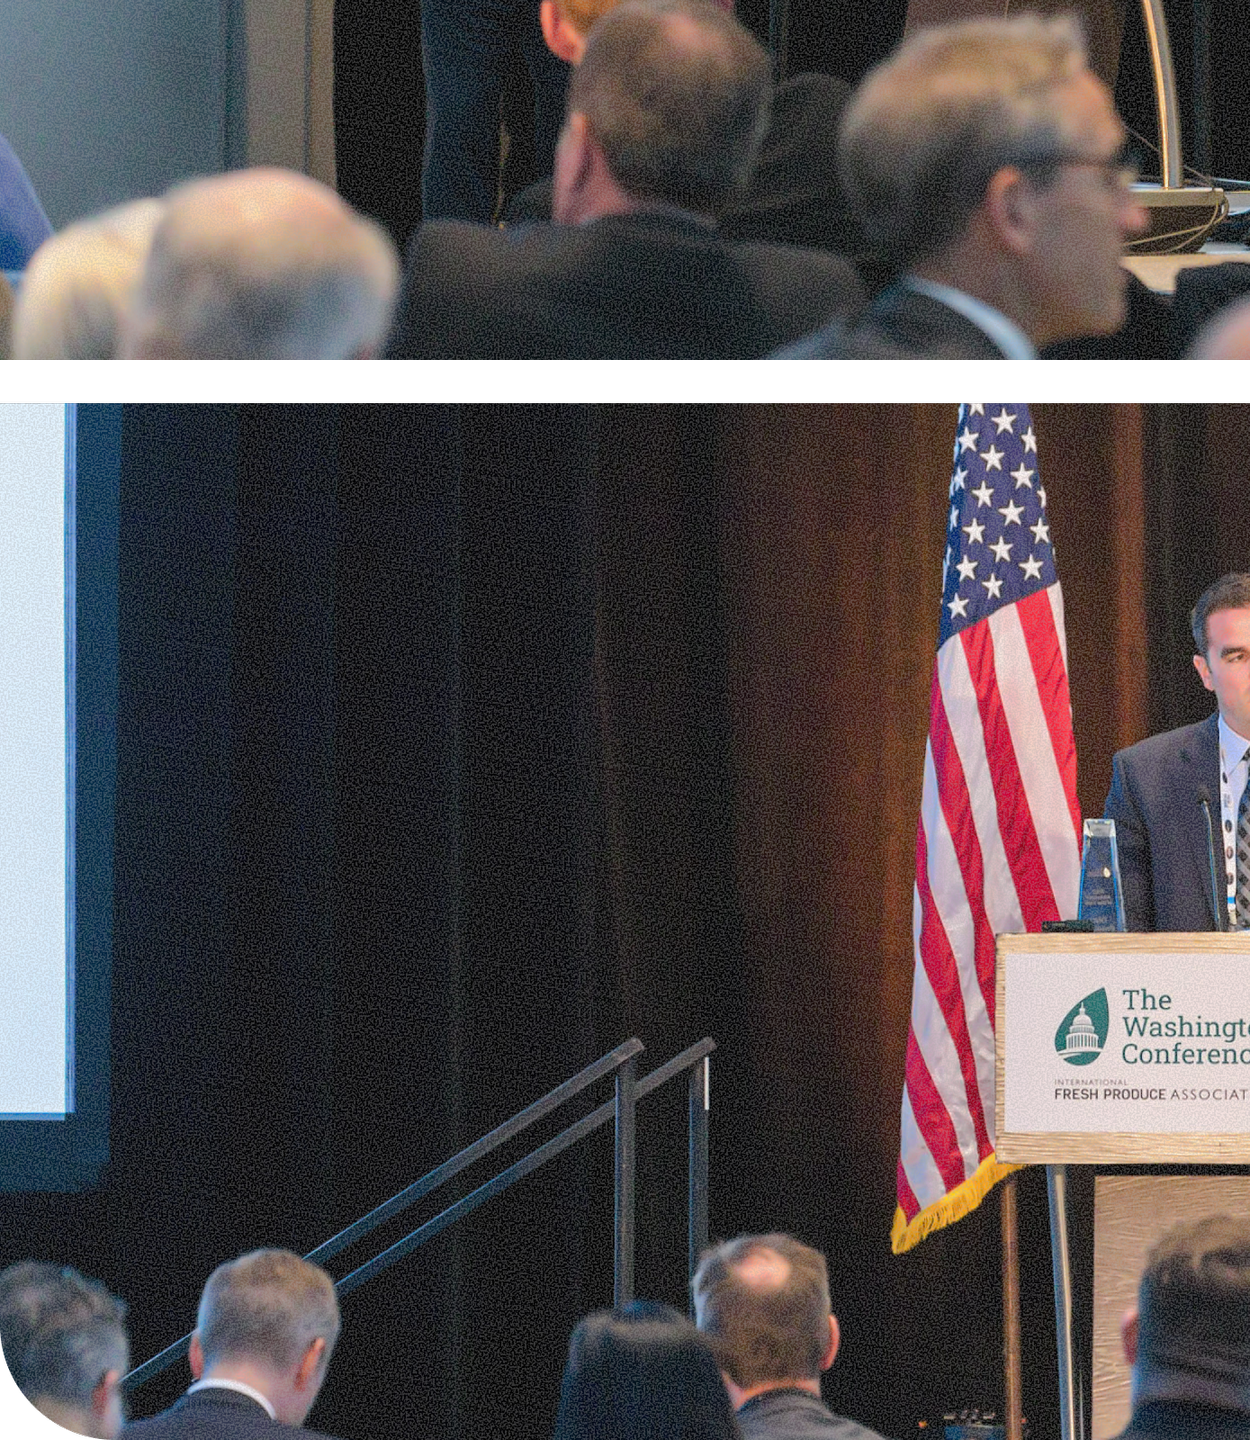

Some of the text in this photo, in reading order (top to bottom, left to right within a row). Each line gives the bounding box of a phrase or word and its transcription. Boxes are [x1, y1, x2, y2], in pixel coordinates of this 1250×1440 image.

[1122, 988, 1172, 1011] The
[1054, 1078, 1128, 1086] INTERNATIONAL
[1054, 1088, 1099, 1100] FRESH
[1103, 1088, 1166, 1100] PRODUCE
